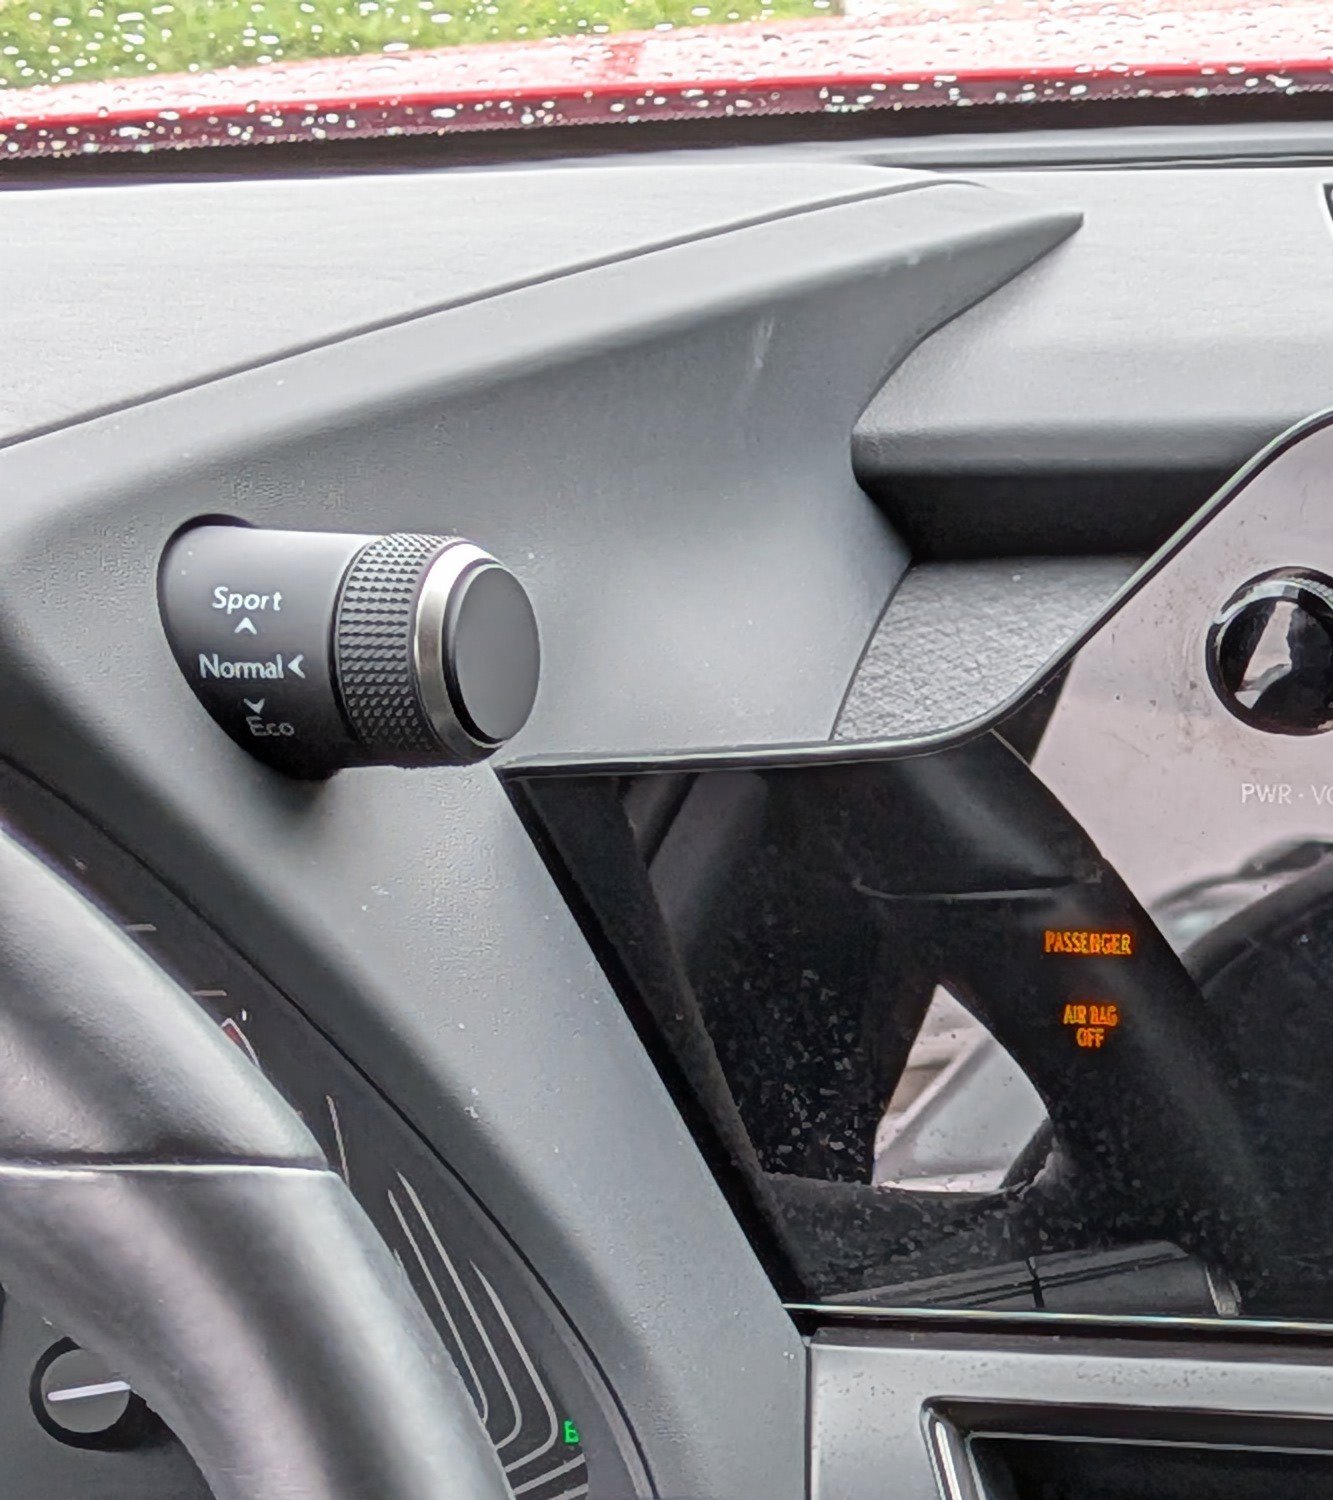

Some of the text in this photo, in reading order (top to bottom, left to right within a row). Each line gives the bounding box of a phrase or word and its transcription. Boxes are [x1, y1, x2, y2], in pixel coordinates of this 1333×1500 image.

[210, 585, 283, 612] Sport
[198, 653, 285, 680] Normal
[246, 714, 296, 737] Eco
[1240, 783, 1292, 805] PWR
[1062, 1004, 1086, 1025] AIR
[1076, 1028, 1104, 1048] OFF
